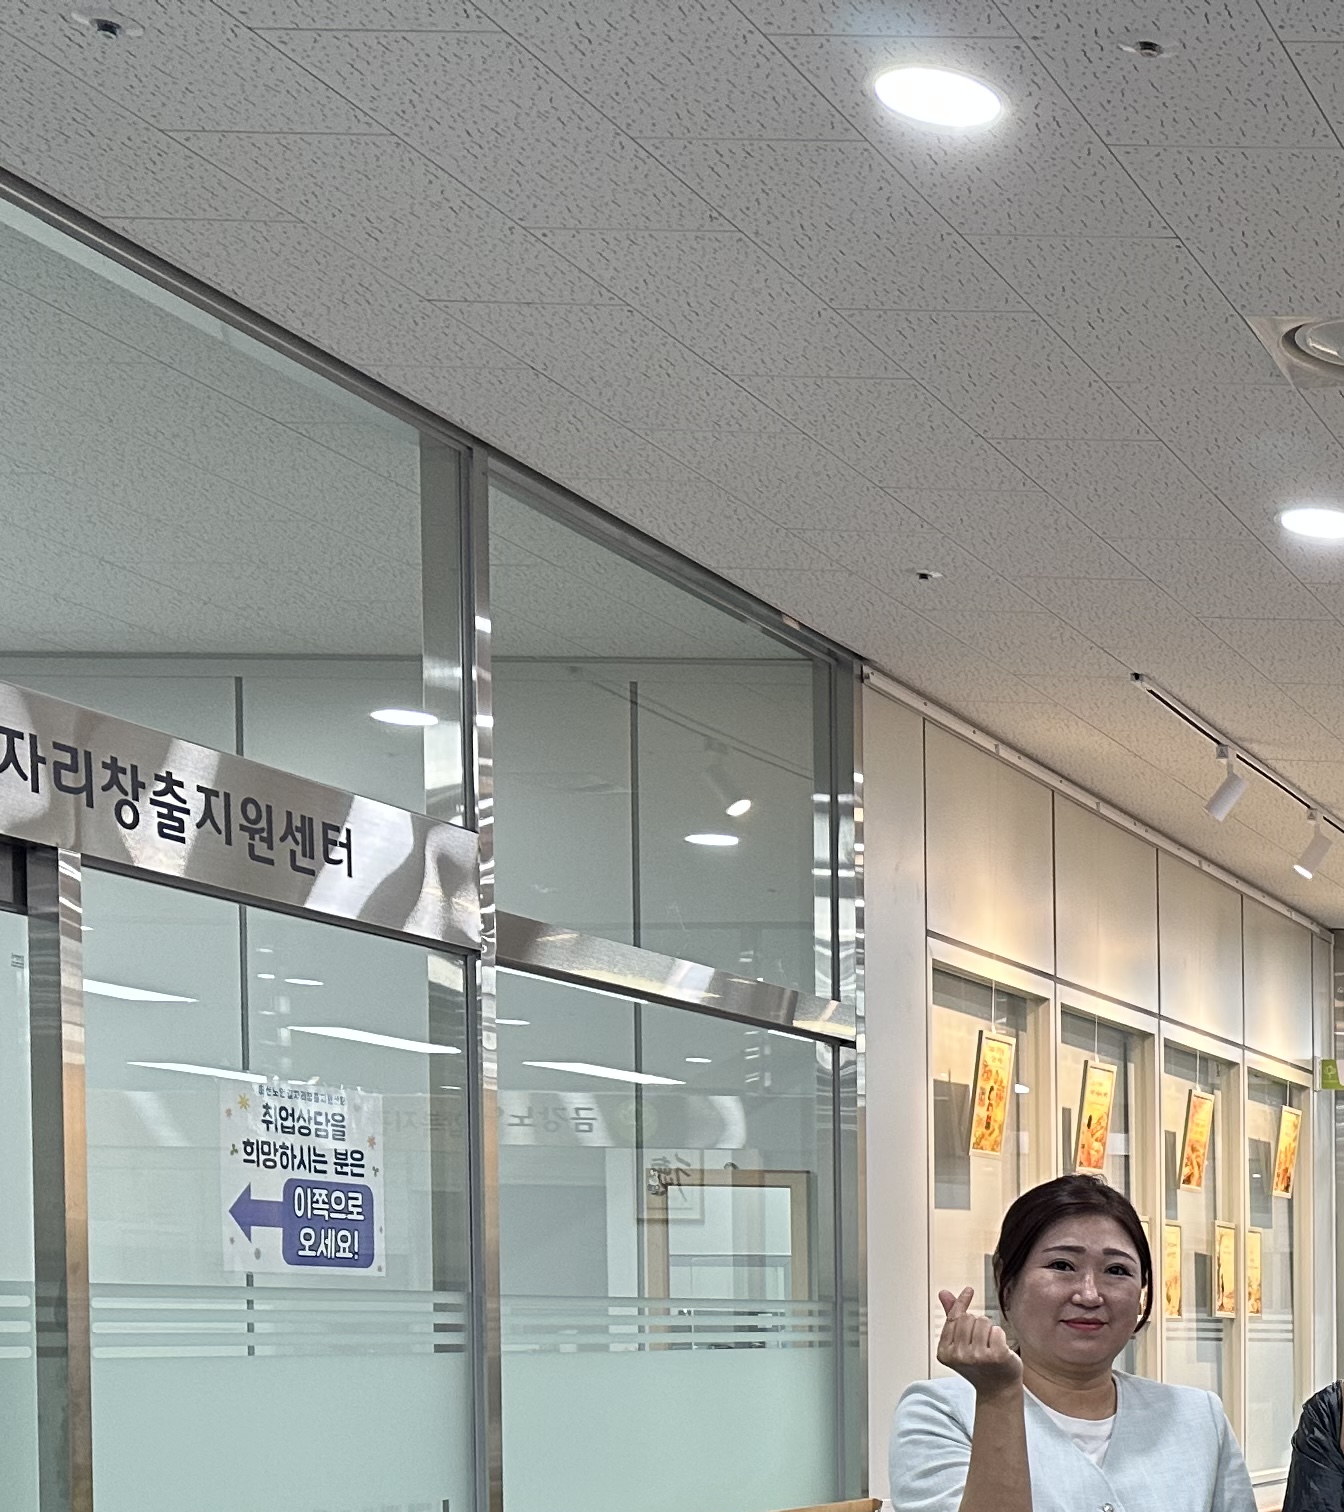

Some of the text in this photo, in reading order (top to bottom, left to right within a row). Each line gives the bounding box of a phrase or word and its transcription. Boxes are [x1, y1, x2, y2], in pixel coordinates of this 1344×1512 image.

[261, 1102, 346, 1142] 취업상담을
[242, 1138, 365, 1178] 희망하시는 분은
[293, 1185, 365, 1221] 이쪽으로
[297, 1226, 359, 1260] 오세요!
